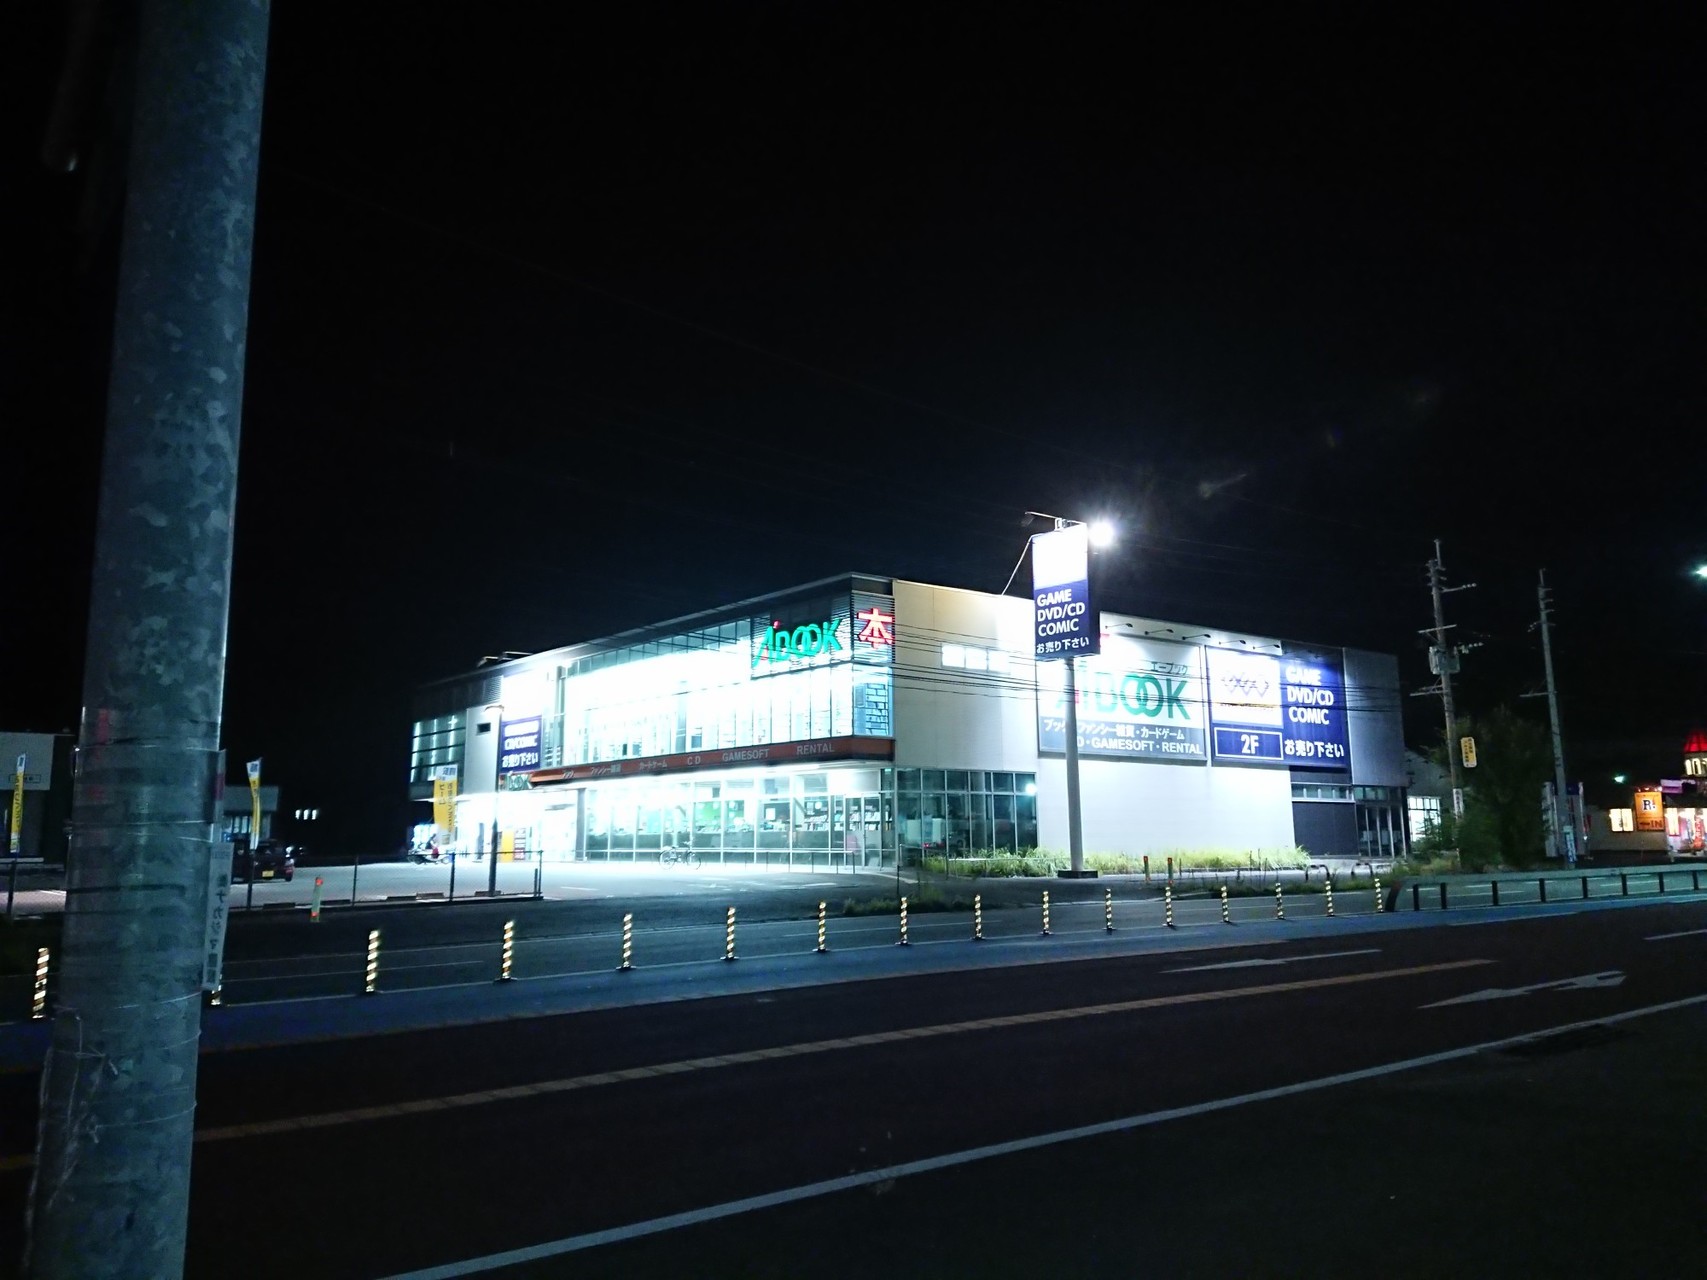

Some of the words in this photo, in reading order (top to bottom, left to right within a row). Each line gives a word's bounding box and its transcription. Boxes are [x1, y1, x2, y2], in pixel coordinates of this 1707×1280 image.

[1036, 588, 1072, 607] GAME
[1037, 602, 1086, 622] DVD/CD
[857, 607, 894, 649] 本
[1038, 618, 1079, 637] COMIC
[1036, 636, 1090, 654] お売り下さい
[1286, 685, 1334, 706] DVD/CD
[1288, 706, 1330, 725] COMIC
[722, 748, 770, 763] GAMESOFT
[796, 743, 835, 756] RENTAL
[1240, 734, 1259, 754] 2F
[1284, 738, 1345, 758] お売り下さい
